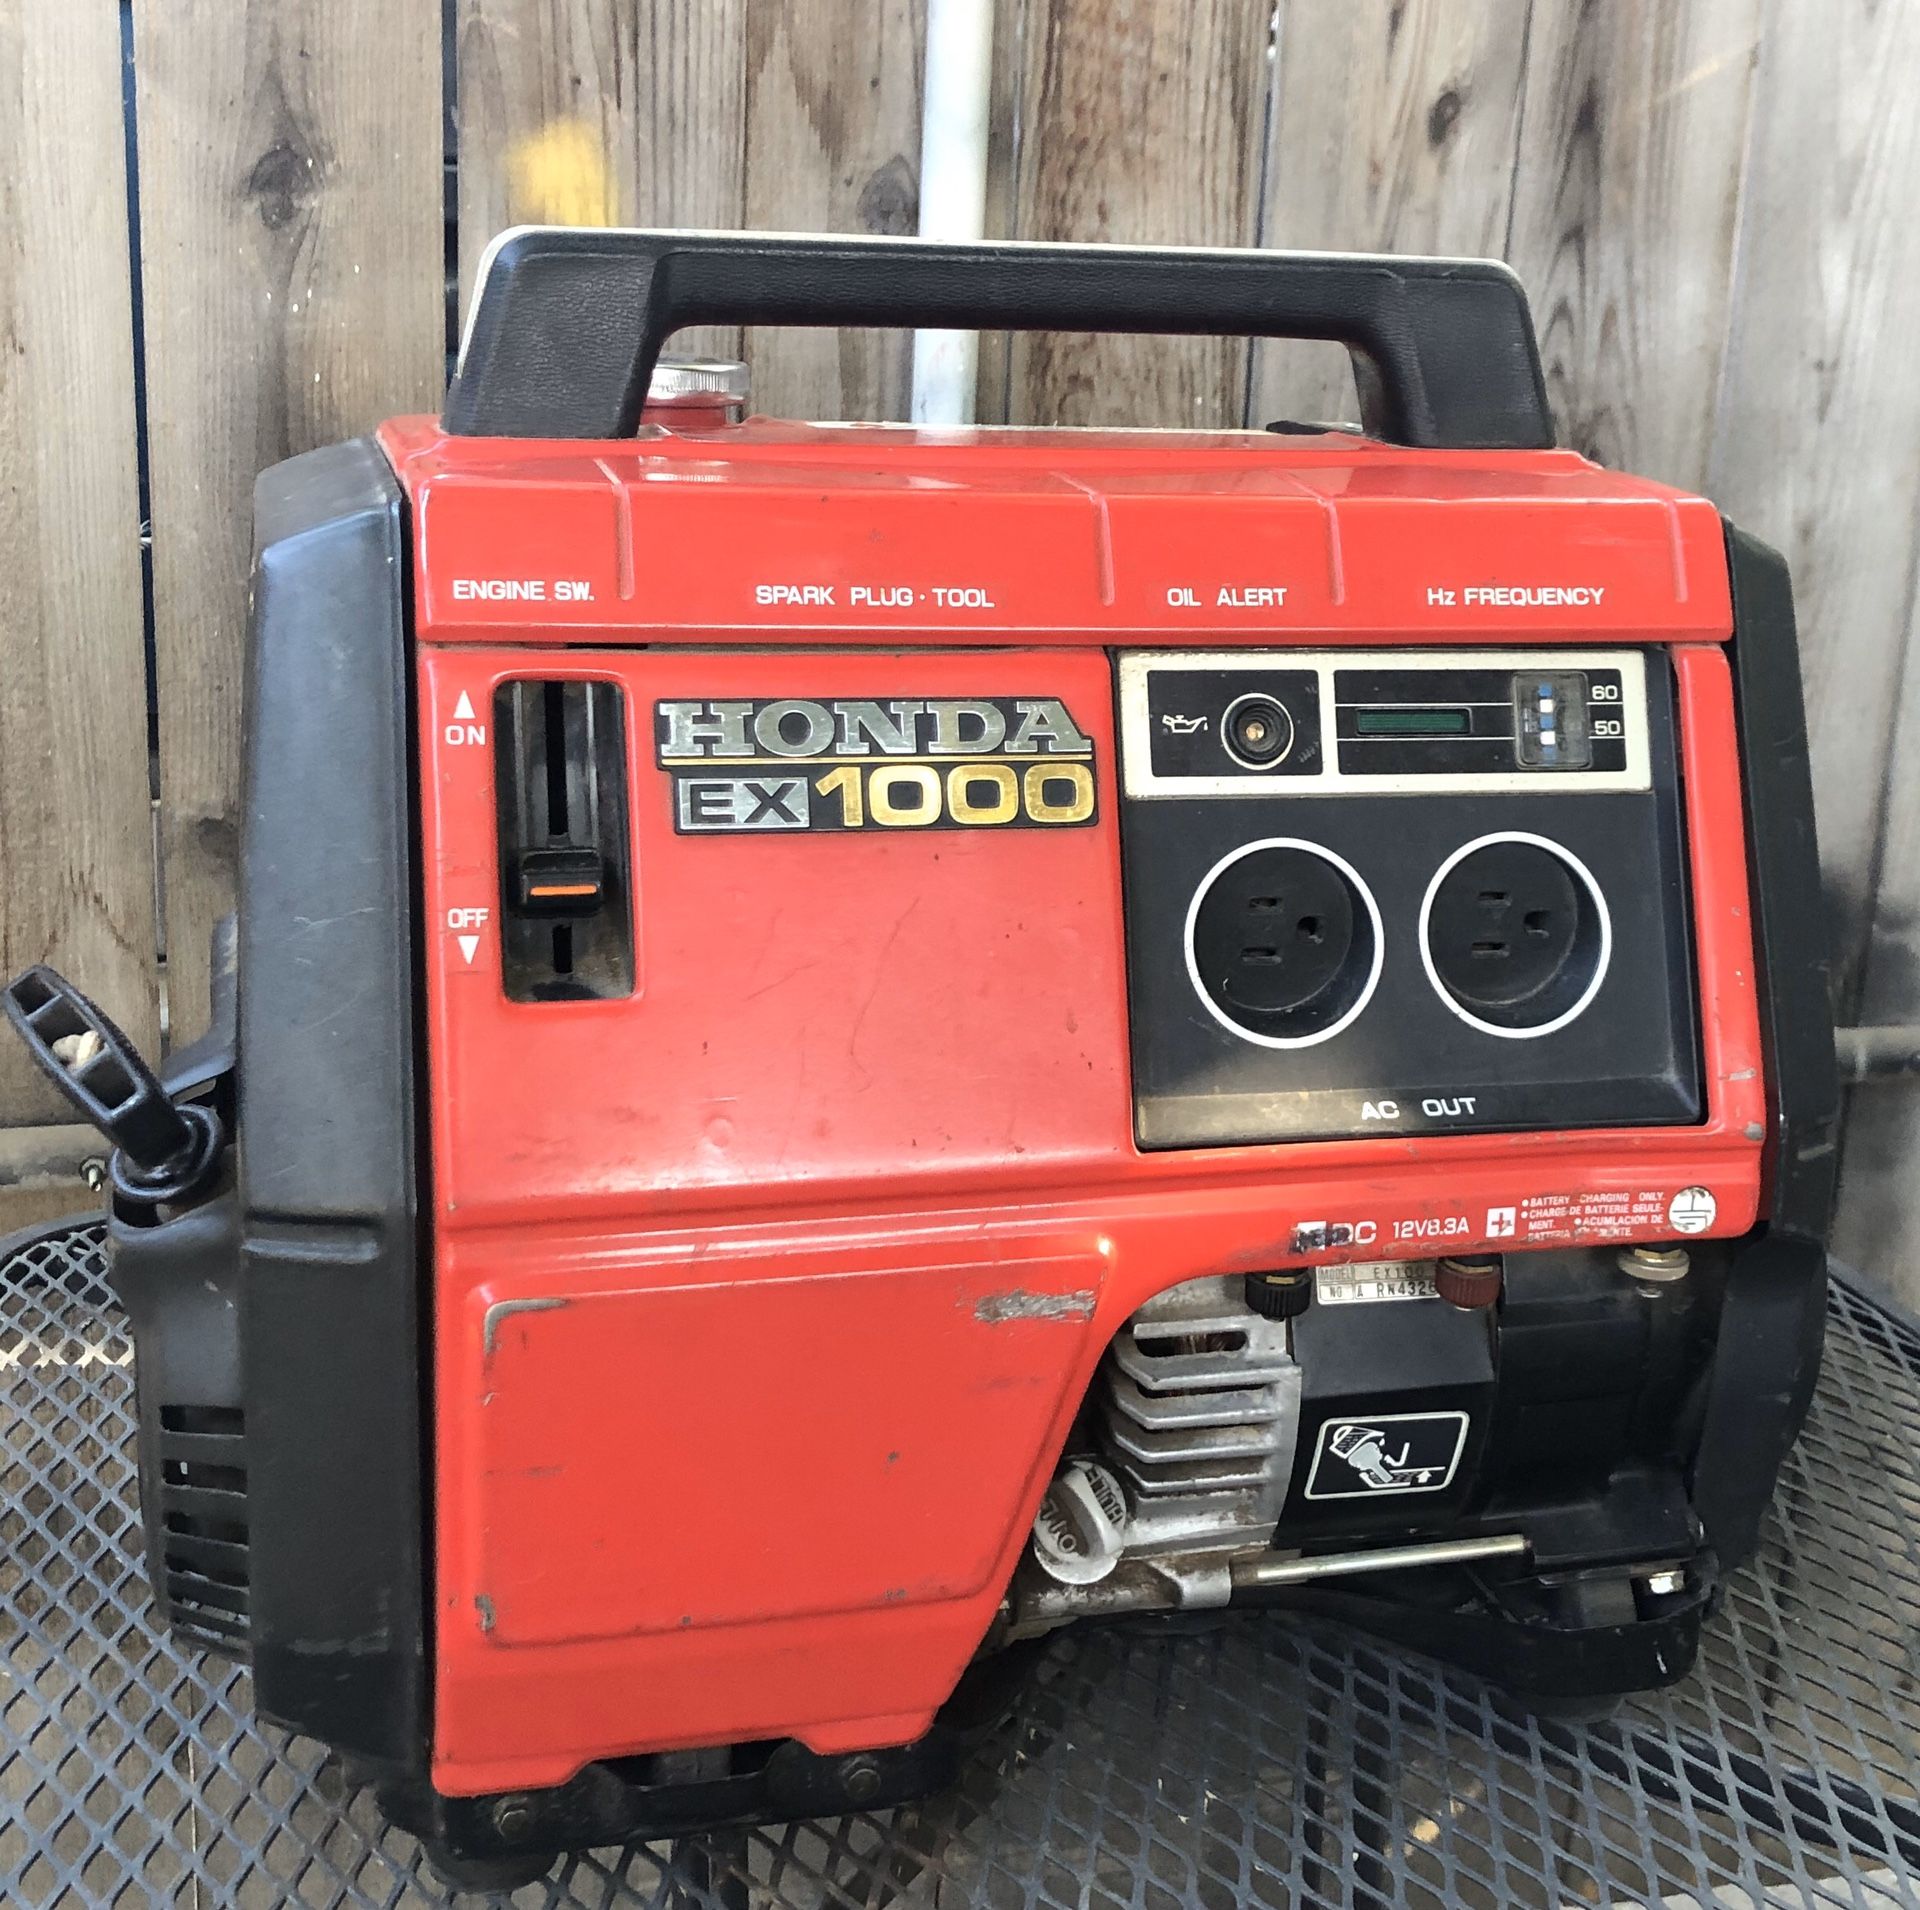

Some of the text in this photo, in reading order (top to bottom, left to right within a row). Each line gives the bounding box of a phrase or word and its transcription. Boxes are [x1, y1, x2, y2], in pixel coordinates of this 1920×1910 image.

[453, 579, 595, 601] ENGINE SW.
[755, 584, 835, 605] SPARK
[1167, 587, 1287, 607] OIL ALERT
[1427, 587, 1604, 607] Hz FREQUENCY
[1591, 684, 1618, 700] 60
[445, 725, 486, 745] ON
[658, 701, 1093, 757] HONDA
[1594, 720, 1621, 736] 50
[447, 908, 489, 929] OFF
[1361, 1097, 1477, 1121] AC OUT
[1529, 1195, 1570, 1207] BATTERY
[1580, 1193, 1630, 1203] CHARGING
[1584, 1203, 1629, 1214] BATTERIE
[1650, 1214, 1664, 1224] DE
